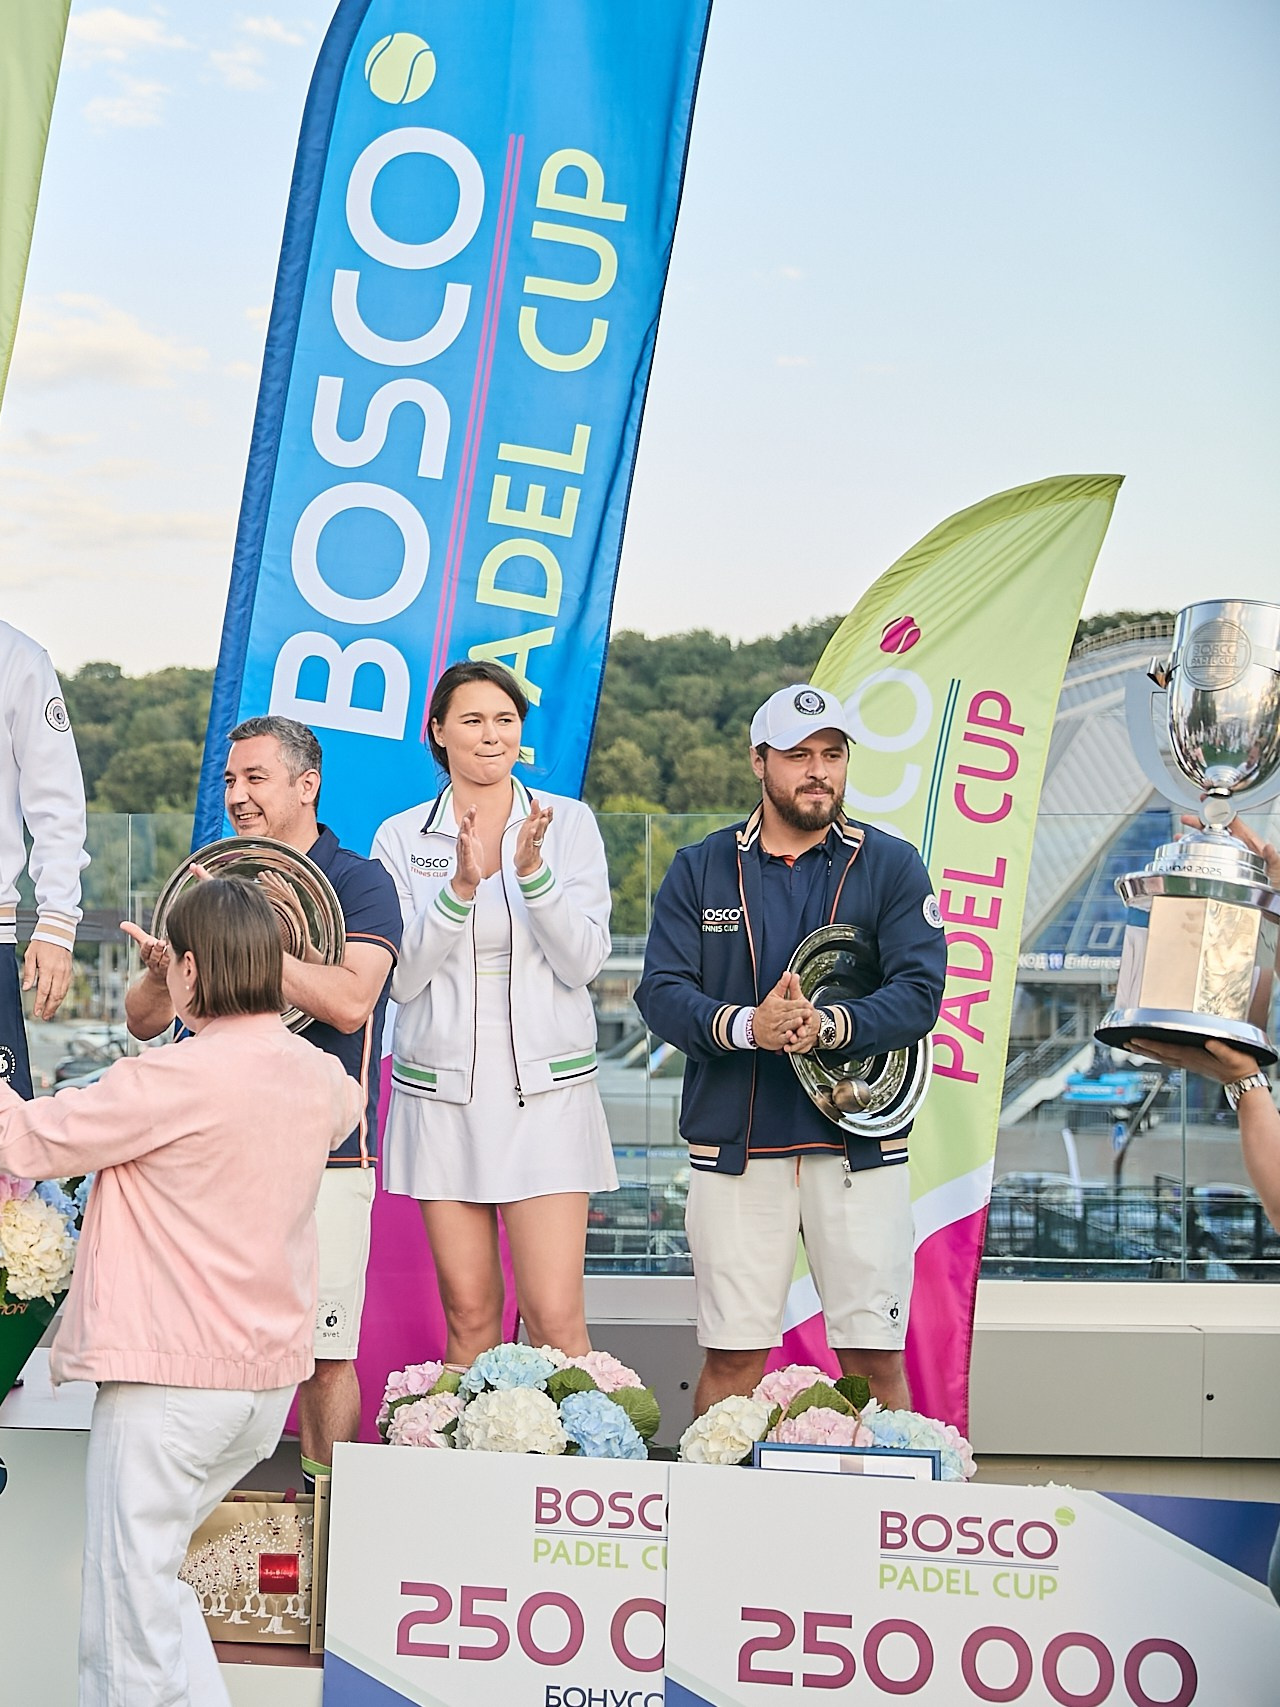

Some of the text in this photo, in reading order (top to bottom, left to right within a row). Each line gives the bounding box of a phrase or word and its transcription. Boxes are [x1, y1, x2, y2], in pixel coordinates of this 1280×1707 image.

[268, 126, 485, 742] BOSCO
[467, 148, 628, 765] ADEL CUP
[410, 853, 450, 868] BOSCO
[931, 689, 1026, 1085] PADEL CUP
[702, 908, 741, 921] OSCO
[702, 924, 723, 933] ENNIS
[534, 1486, 669, 1532] BOSC
[532, 1537, 629, 1569] PADEL
[878, 1509, 1060, 1561] BOSCO
[878, 1563, 1059, 1601] PADEL CUP
[395, 1580, 585, 1667] 250
[737, 1605, 1199, 1707] 250 000
[544, 1684, 665, 1707] БОНУС
